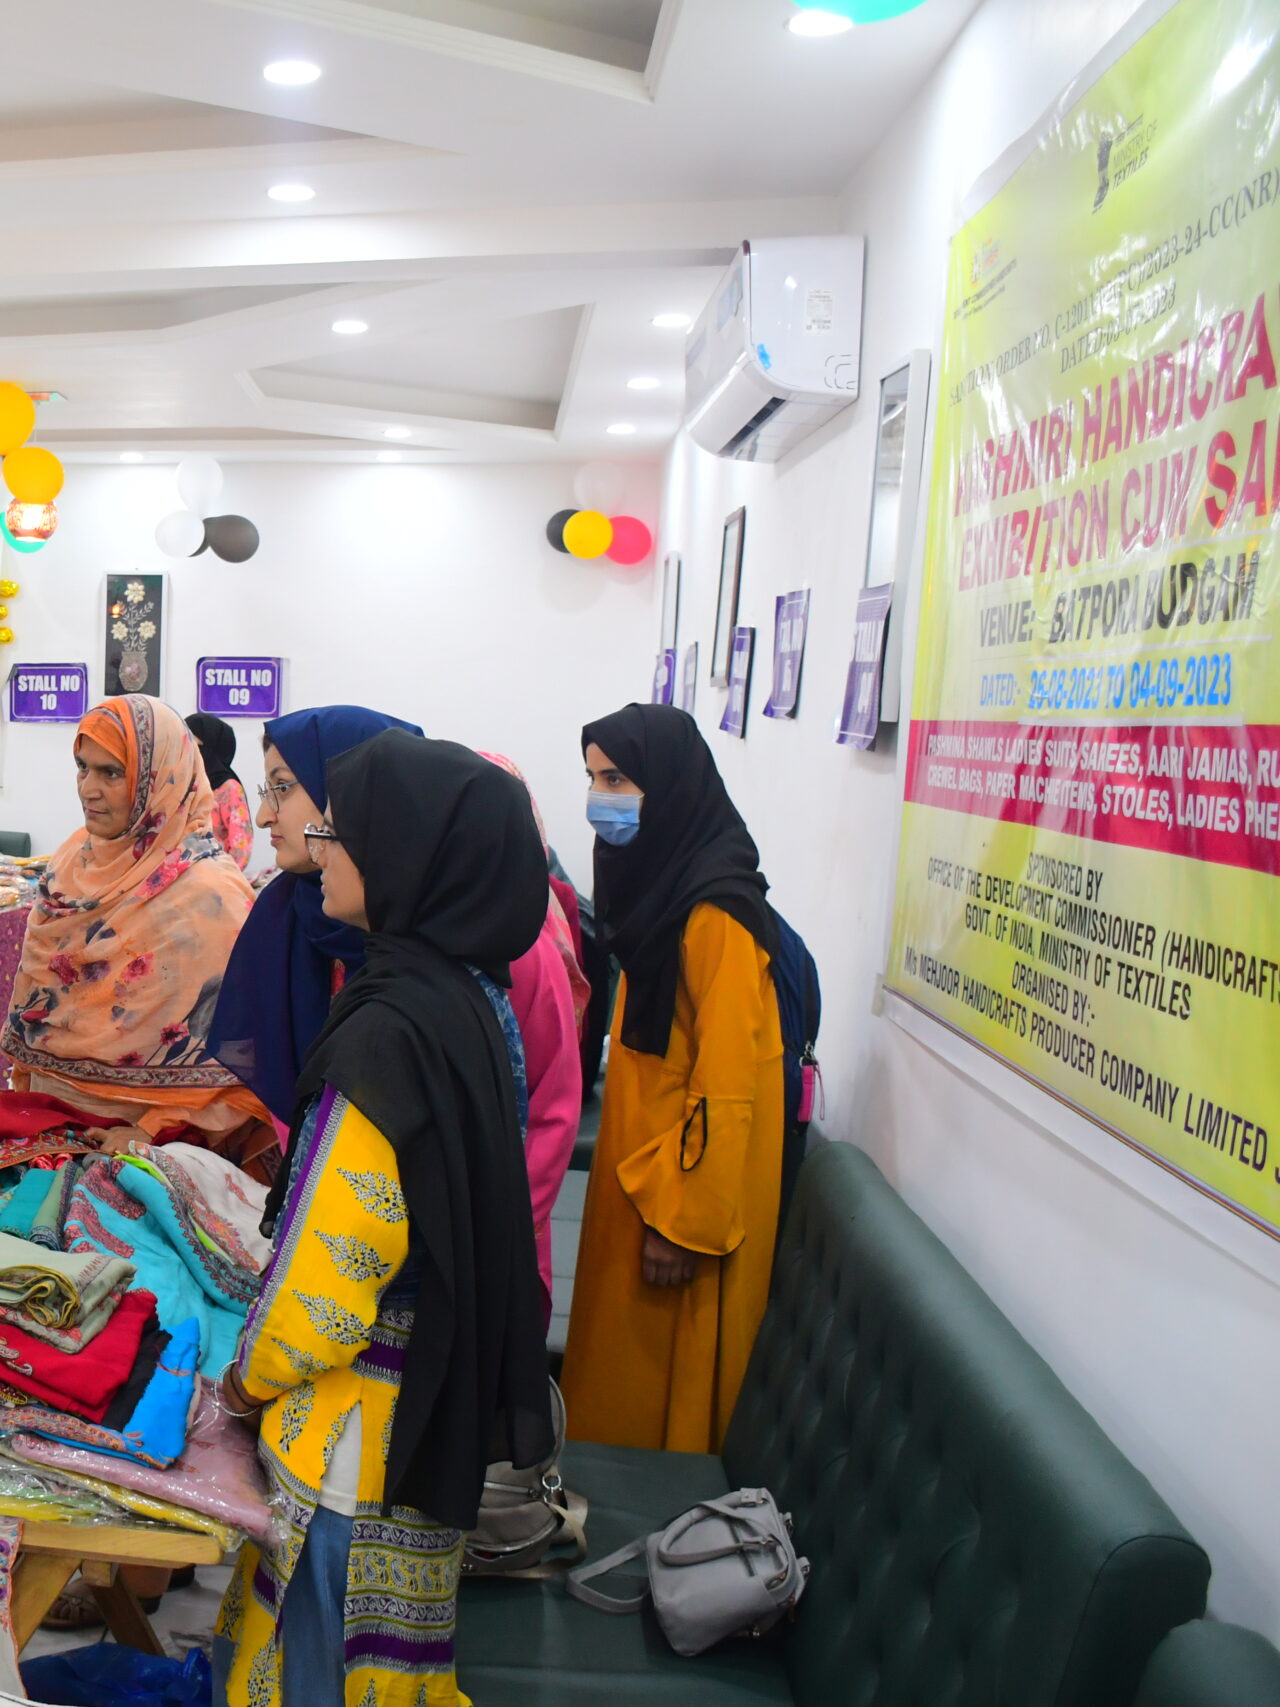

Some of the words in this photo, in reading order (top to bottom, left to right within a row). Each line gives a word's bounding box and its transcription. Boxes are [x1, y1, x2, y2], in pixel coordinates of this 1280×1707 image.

[996, 336, 1031, 377] ORDER
[959, 479, 1109, 592] EXHIBITION
[1121, 445, 1198, 554] CUM
[1204, 413, 1280, 530] SA
[1048, 575, 1140, 644] BATPORA
[1142, 551, 1260, 630] BUDGAM
[18, 675, 58, 692] STALL
[61, 674, 81, 691] NO
[40, 694, 57, 711] 10
[205, 669, 246, 686] STALL
[251, 669, 272, 686] NO
[228, 689, 250, 706] 09
[1028, 665, 1105, 709] 26-08-2023
[1105, 664, 1126, 709] TO
[1130, 653, 1232, 708] 04-09-2023
[928, 734, 965, 758] PASHMINA
[967, 736, 1003, 762] SHAWLS
[1005, 738, 1043, 766] LADIES
[1080, 742, 1144, 782] SAREES,
[1147, 745, 1185, 779] AARI
[1187, 747, 1252, 792] JAMAS,
[927, 765, 957, 790] CREWEL
[958, 768, 984, 798] BAGS,
[986, 771, 1016, 799] PAPER
[1101, 784, 1173, 831] STOLES,
[1177, 793, 1240, 834] LADIES
[1027, 851, 1083, 898] SPONSORED
[1086, 869, 1104, 903] BY
[927, 856, 952, 888] OFFICE
[954, 865, 965, 892] OF
[966, 869, 982, 899] THE
[985, 875, 1054, 924] DEVELOPMENT
[1055, 897, 1157, 961] COMMISSIONER
[965, 903, 992, 937] GOVT.
[995, 913, 1009, 943] OF
[1038, 931, 1091, 981] MINISTRY
[1094, 953, 1112, 989] OF
[1116, 961, 1192, 1021] TEXTILES
[1012, 960, 1069, 1015] ORGANISED
[1072, 989, 1095, 1027] BY:-
[919, 953, 960, 999] MEHJOOR
[962, 975, 1027, 1038] HANDICRAFTS
[1030, 1011, 1096, 1080] PRODUCER
[1100, 1049, 1179, 1124] COMPANY
[1184, 1092, 1268, 1172] LIMITED
